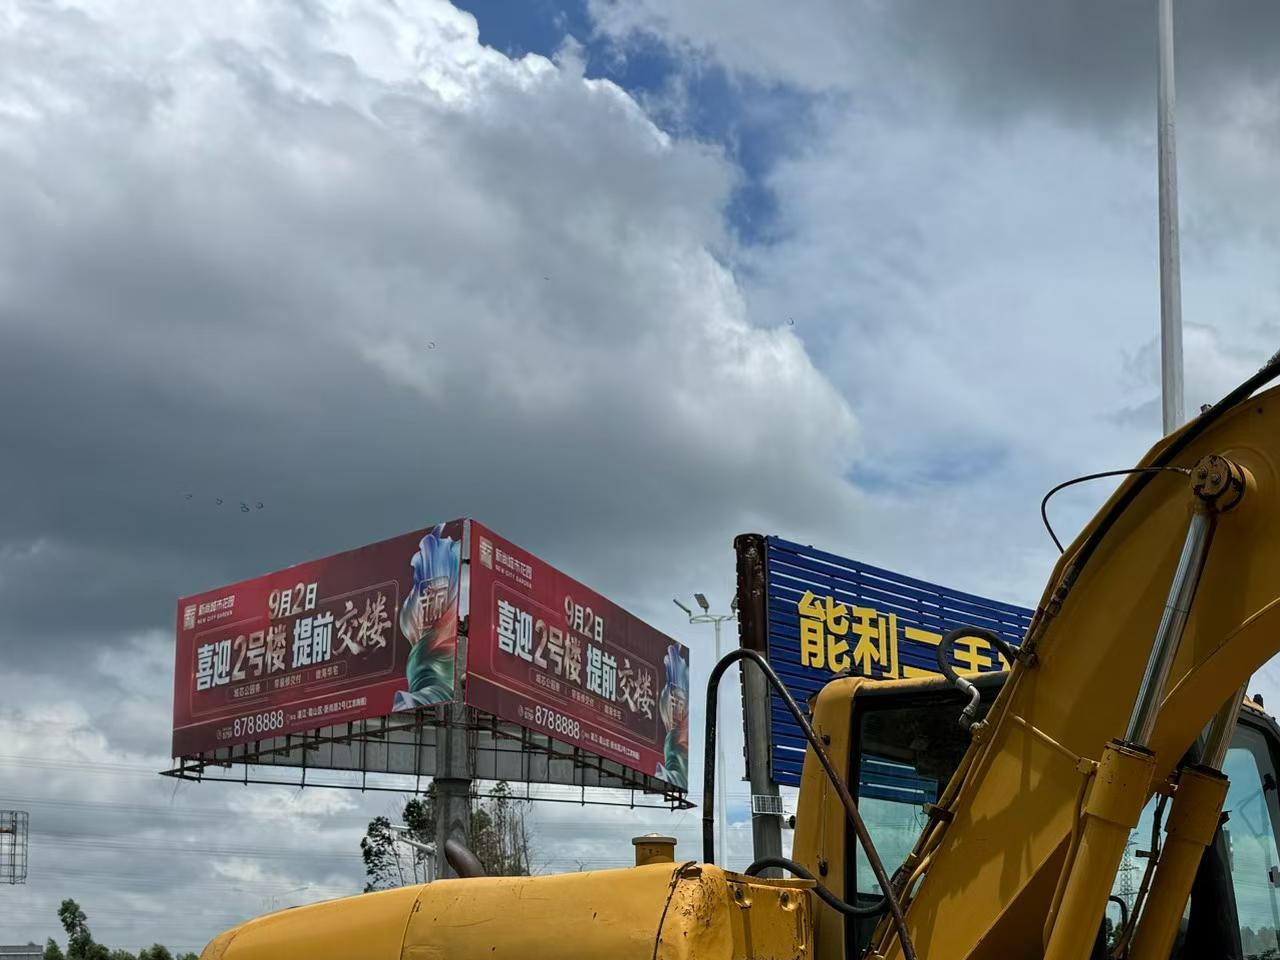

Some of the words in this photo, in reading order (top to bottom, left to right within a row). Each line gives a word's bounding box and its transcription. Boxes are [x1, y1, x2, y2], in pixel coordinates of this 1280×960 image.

[196, 624, 287, 691] 喜迎2号楼
[291, 591, 393, 669] 提前交楼
[268, 582, 318, 619] 9月2日
[564, 595, 604, 643] 9月2日
[797, 590, 1012, 680] 能利二手
[497, 600, 582, 686] 喜迎2号楼
[586, 643, 656, 720] 提前交楼
